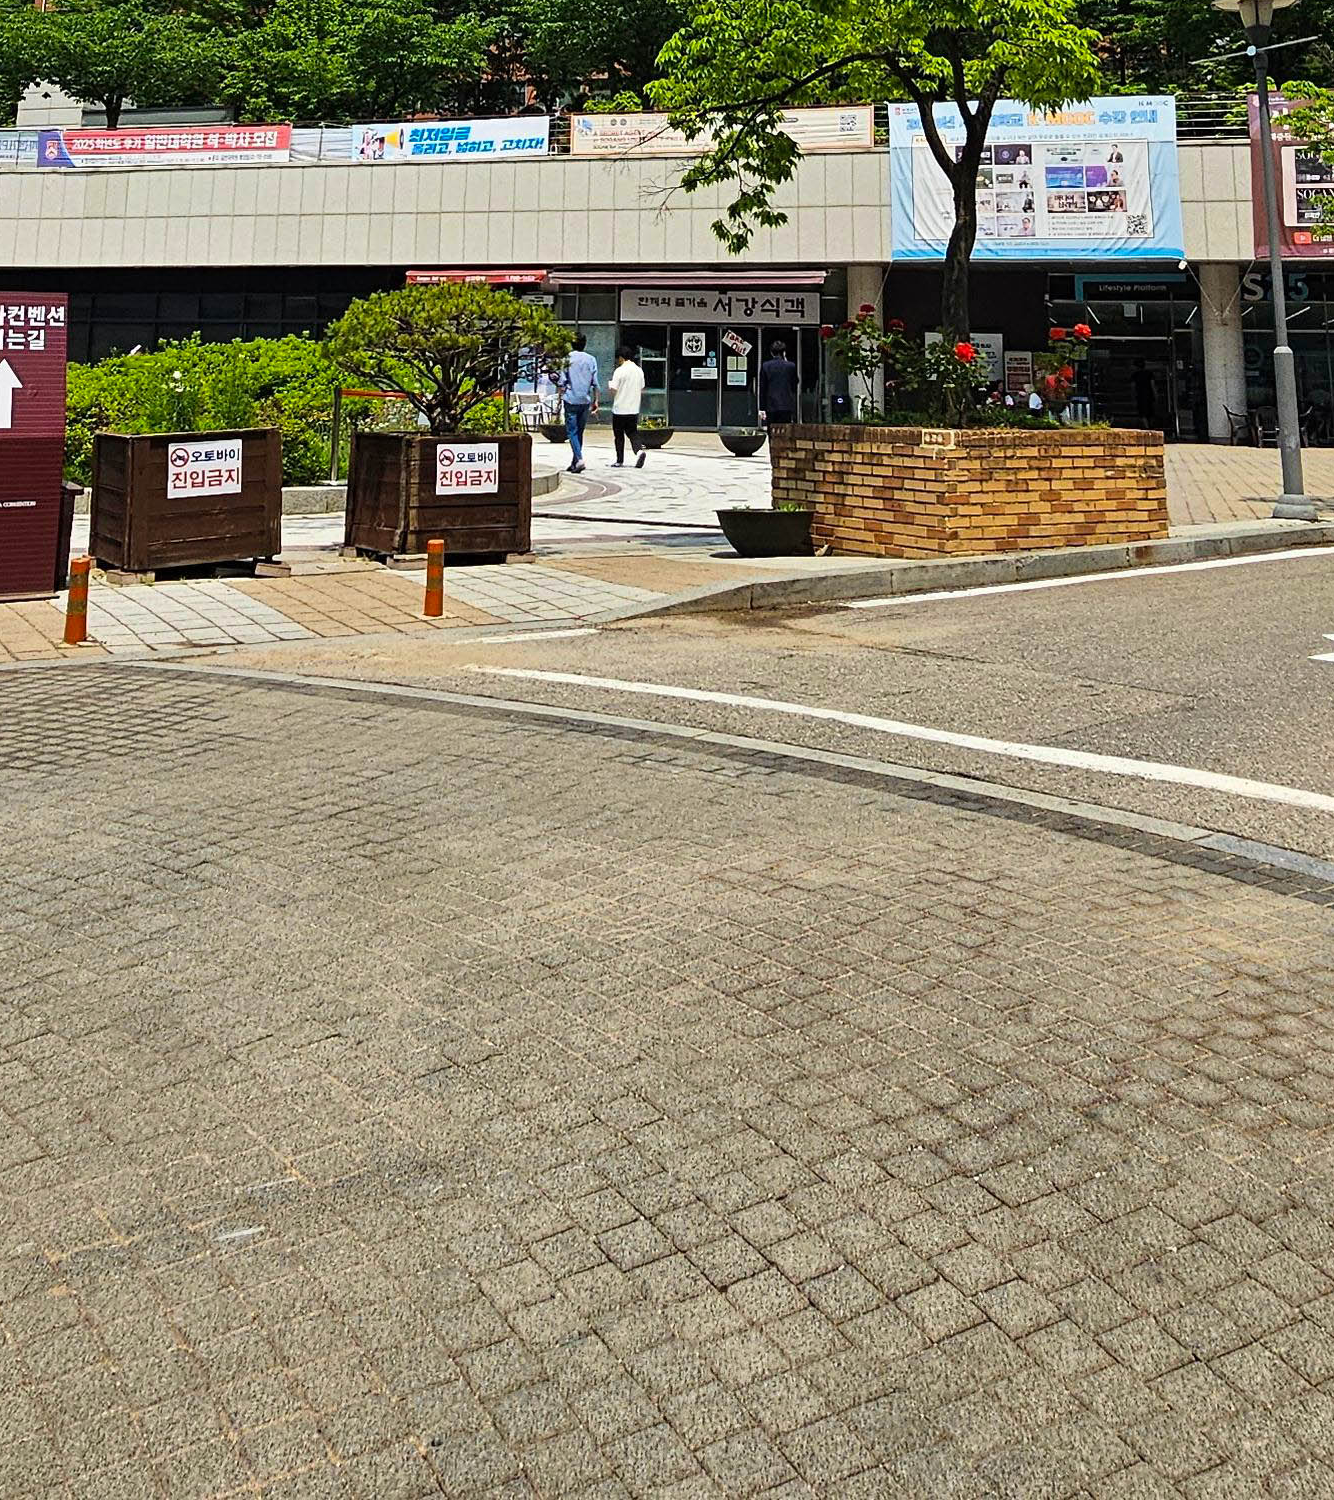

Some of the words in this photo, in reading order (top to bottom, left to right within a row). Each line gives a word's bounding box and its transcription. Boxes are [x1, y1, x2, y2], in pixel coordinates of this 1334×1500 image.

[408, 126, 472, 143] 최저임금
[500, 137, 545, 151] 고치자!
[1099, 284, 1131, 292] Lifestyle
[713, 297, 805, 318] 서강식객
[191, 447, 240, 462] 오토바이
[456, 451, 497, 464] 오토바이
[172, 467, 240, 489] 진입금지
[439, 469, 497, 487] 진입금지
